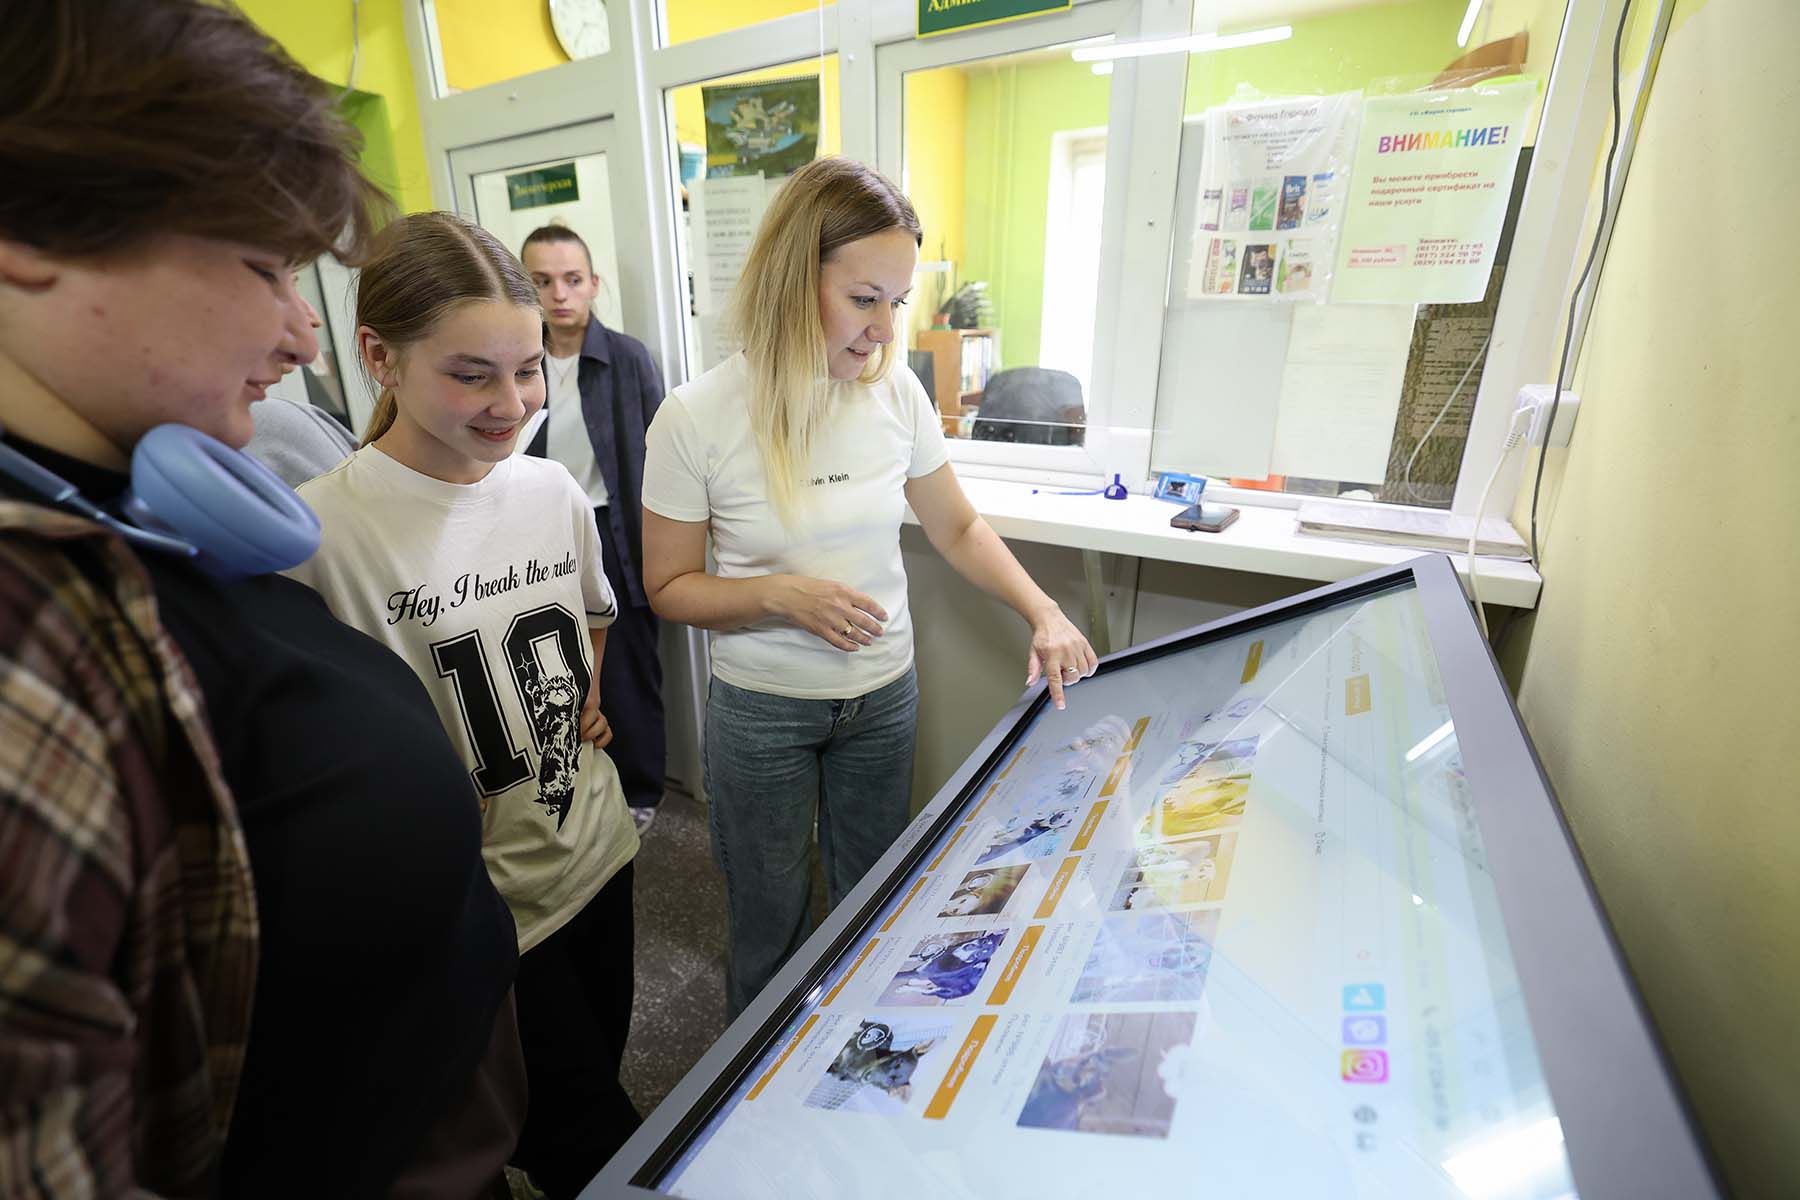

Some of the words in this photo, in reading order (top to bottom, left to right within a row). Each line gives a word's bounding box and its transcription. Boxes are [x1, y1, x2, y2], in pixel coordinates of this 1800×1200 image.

[1378, 125, 1509, 154] ВНИМАНИЕ!
[1372, 176, 1387, 184] Вы
[1388, 174, 1422, 183] можете
[1424, 171, 1479, 182] приобрести
[1370, 185, 1425, 196] подарочный
[1426, 182, 1482, 193] сертификат
[1483, 181, 1496, 189] на
[1394, 198, 1423, 207] услуги
[828, 473, 850, 484] Klein
[386, 584, 445, 627] Hey,
[450, 573, 471, 608] I
[474, 565, 520, 601] break
[525, 559, 549, 585] the
[551, 552, 577, 579] rules
[429, 602, 593, 799] 10
